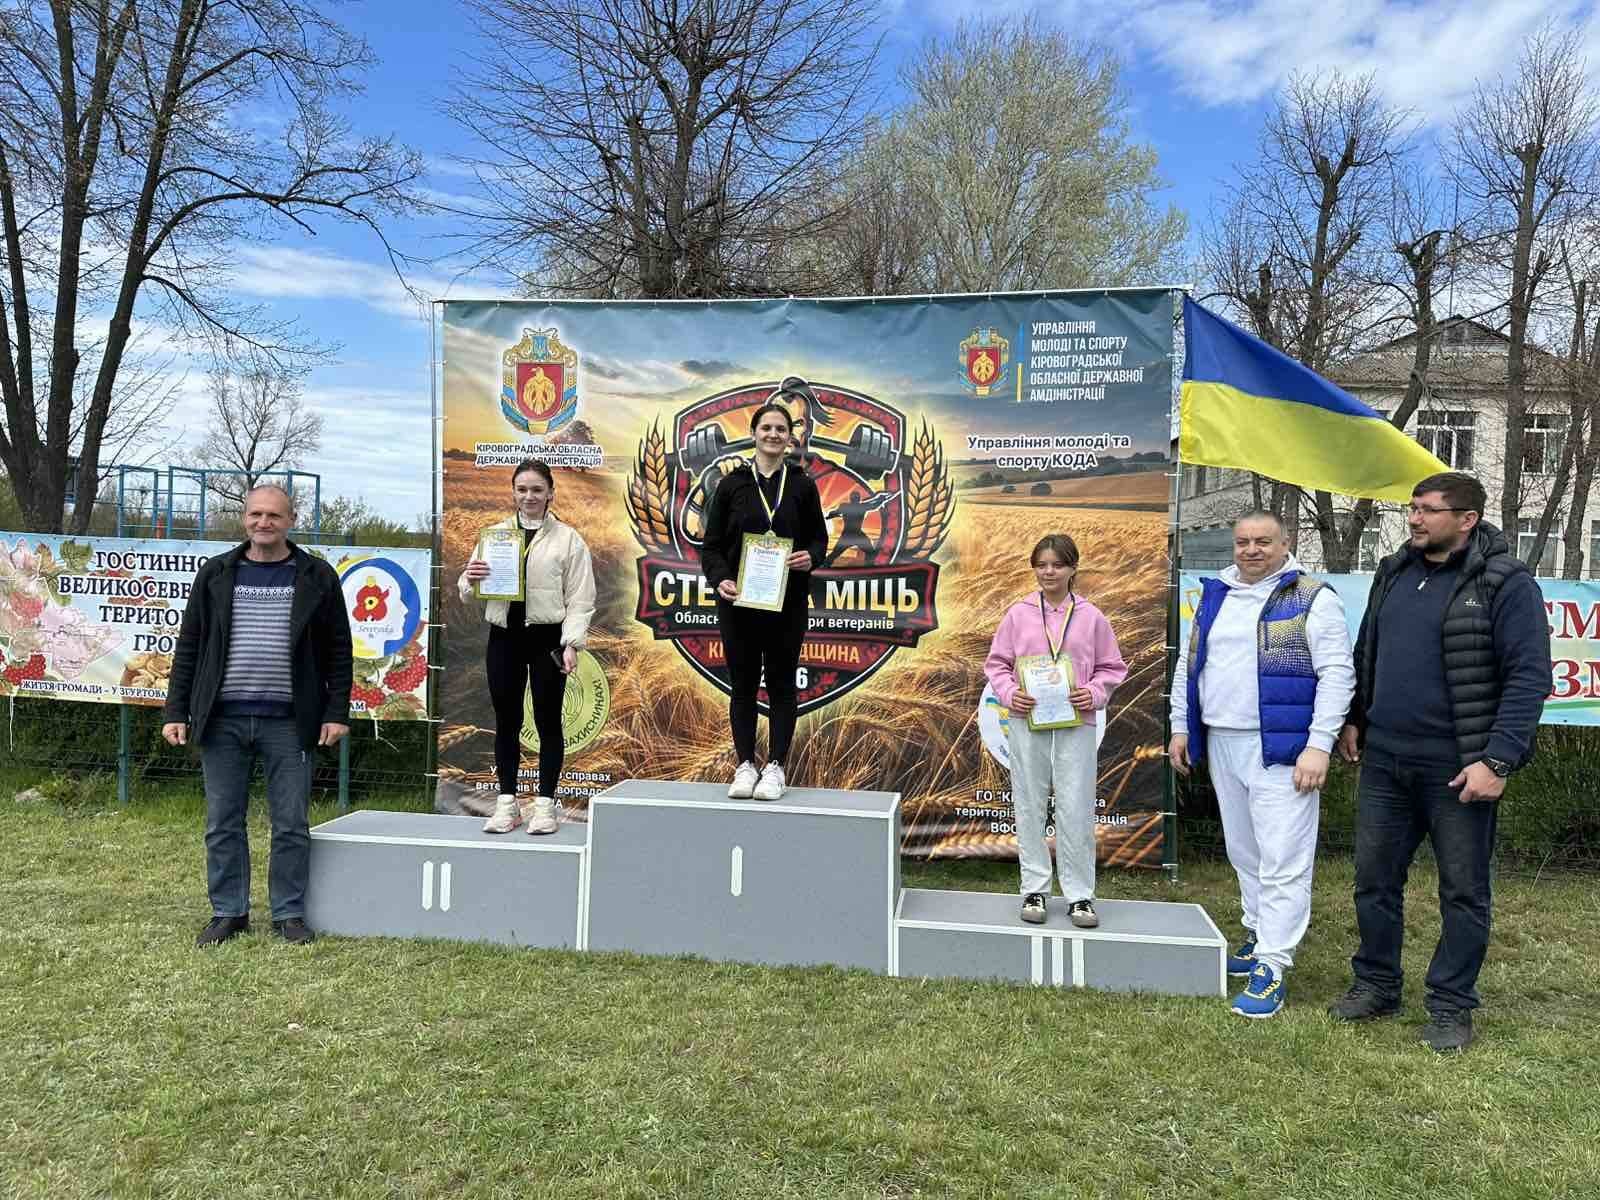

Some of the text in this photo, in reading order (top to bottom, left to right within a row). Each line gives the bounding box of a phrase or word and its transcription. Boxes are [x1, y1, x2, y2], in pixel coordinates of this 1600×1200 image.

[1031, 320, 1096, 336] УПРАВЛІННЯ
[1031, 336, 1128, 353] МОЛОДІ ТА СПОРТУ
[1030, 351, 1123, 369] КІРОВОГРАДСЬКОЇ
[1030, 366, 1145, 385] ОБЛАСНОЇ ДЕРЖАВНОЇ
[477, 444, 602, 455] КІРОВОГРАДСЬКА ОБЛАСНА
[967, 434, 1129, 451] Управління молоді та
[998, 453, 1097, 470] спорту КОДА
[59, 576, 191, 599] ВЕЛИКОСЕВЕ
[825, 577, 920, 618] МІЦЬ
[828, 617, 895, 631] ветеранів
[23, 680, 55, 690] ЖИТТЯ
[57, 682, 103, 694] ГРОМАДИ
[111, 686, 118, 695] У
[565, 772, 611, 782] справах
[976, 790, 993, 801] ГО
